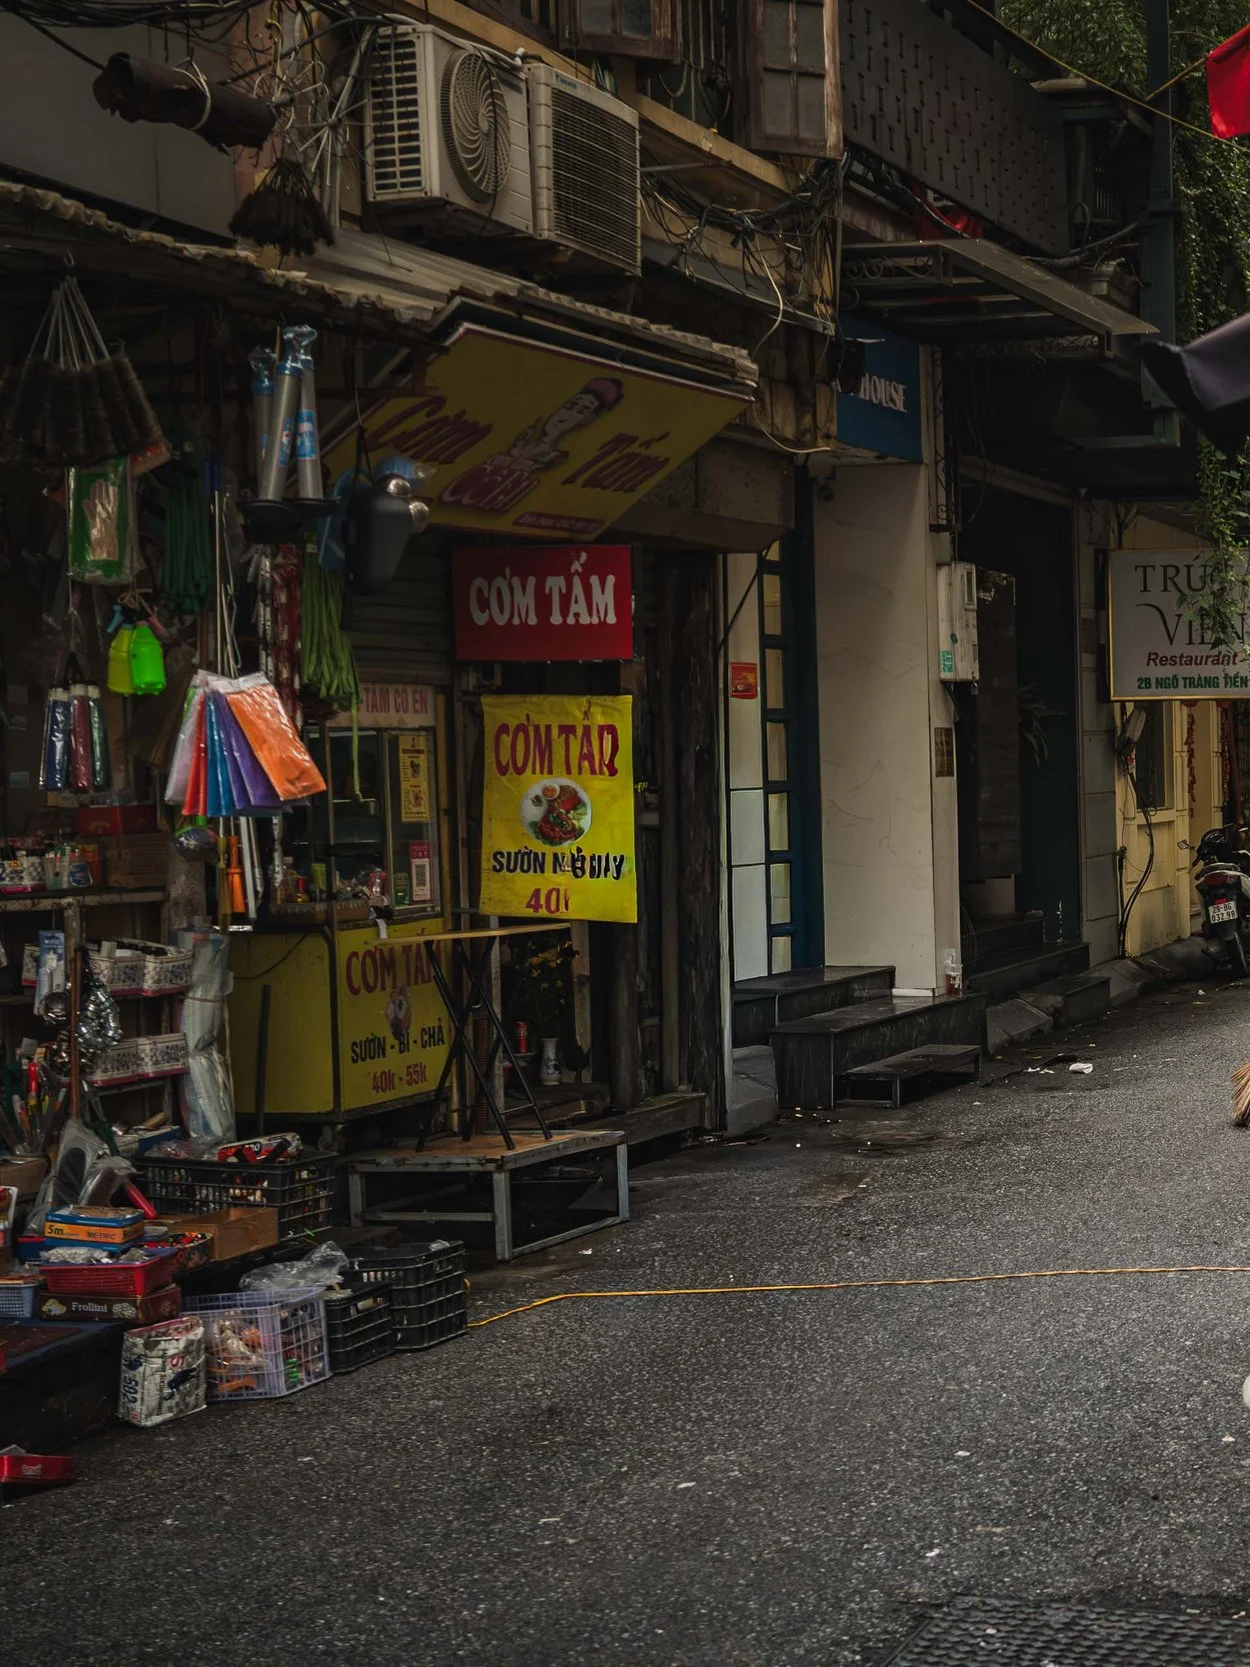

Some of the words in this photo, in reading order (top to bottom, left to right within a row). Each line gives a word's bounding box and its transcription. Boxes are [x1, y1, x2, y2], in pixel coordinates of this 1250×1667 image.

[1134, 554, 1222, 596] TRÚ
[469, 566, 538, 626] CƠM
[545, 551, 617, 625] TẤM
[1146, 652, 1238, 667] Restaurant
[1137, 677, 1152, 690] 2B
[492, 845, 546, 874] SƯỜN
[71, 1302, 108, 1314] Frollini
